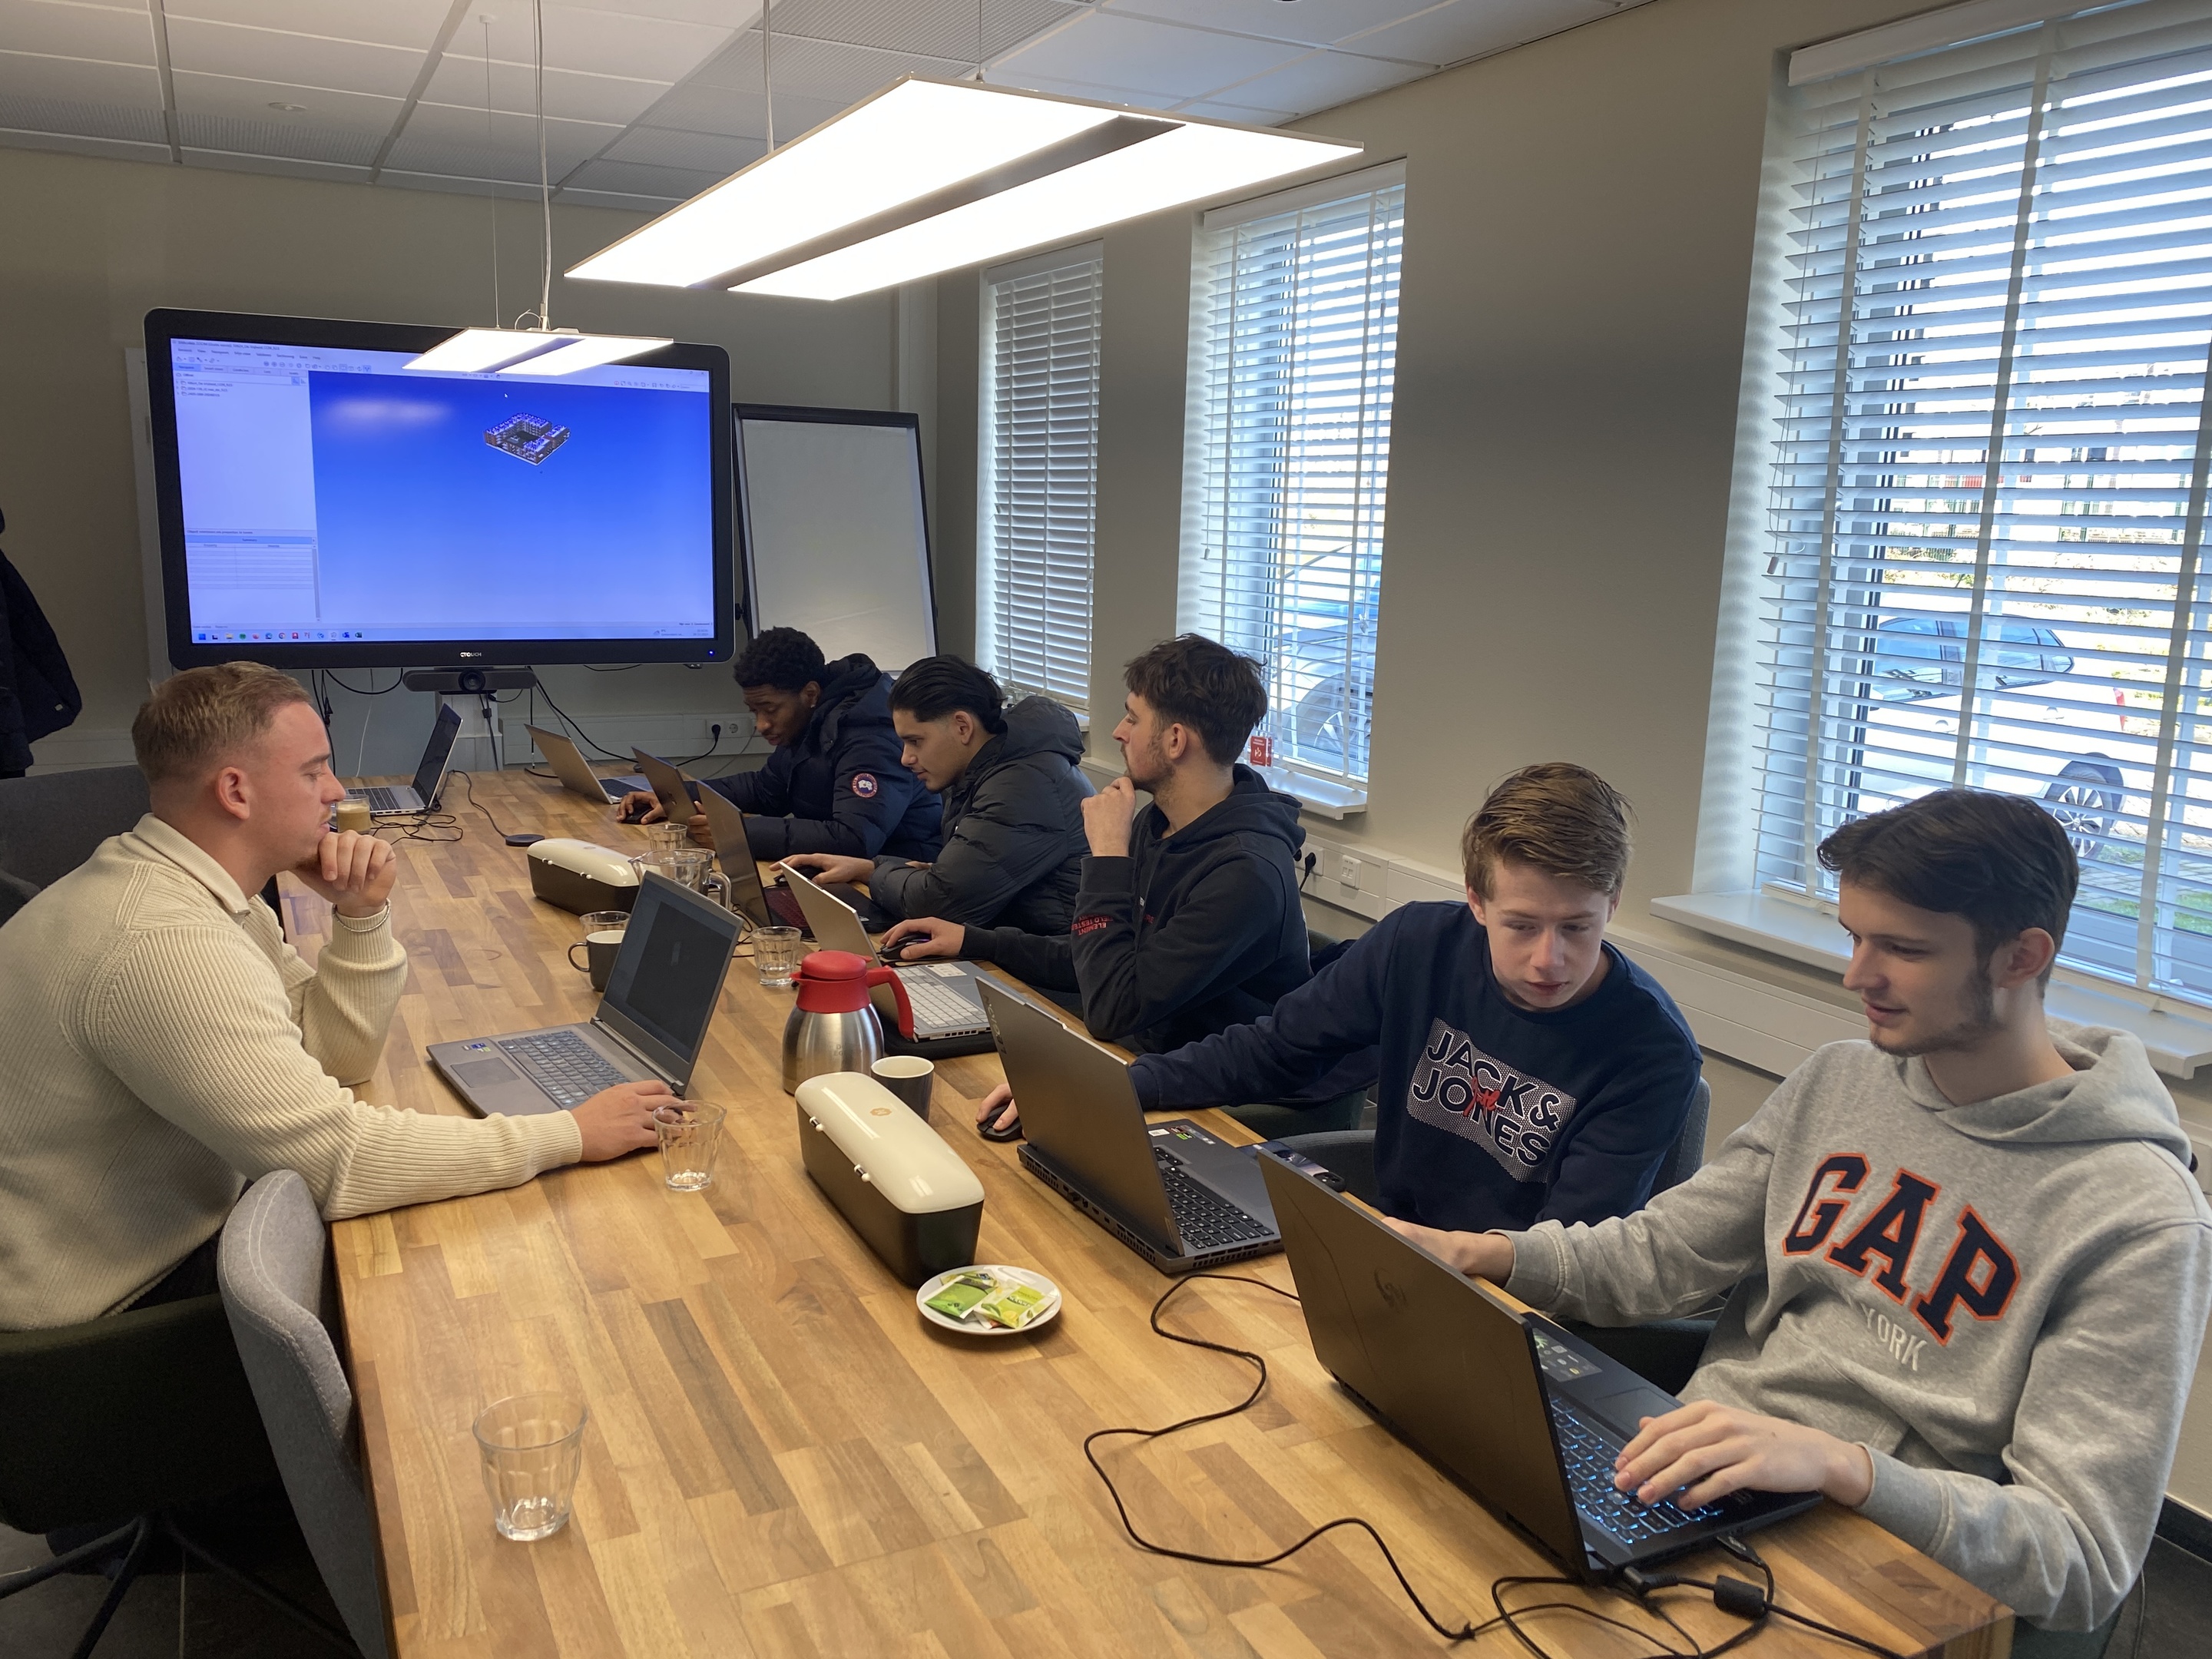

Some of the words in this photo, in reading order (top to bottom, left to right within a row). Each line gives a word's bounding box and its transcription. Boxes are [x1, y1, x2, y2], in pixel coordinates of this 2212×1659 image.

[1078, 922, 1107, 935] ELEMENT
[1412, 1068, 1551, 1167] JONES
[1782, 1152, 2022, 1347] GAP
[1860, 1303, 1928, 1372] YORK
